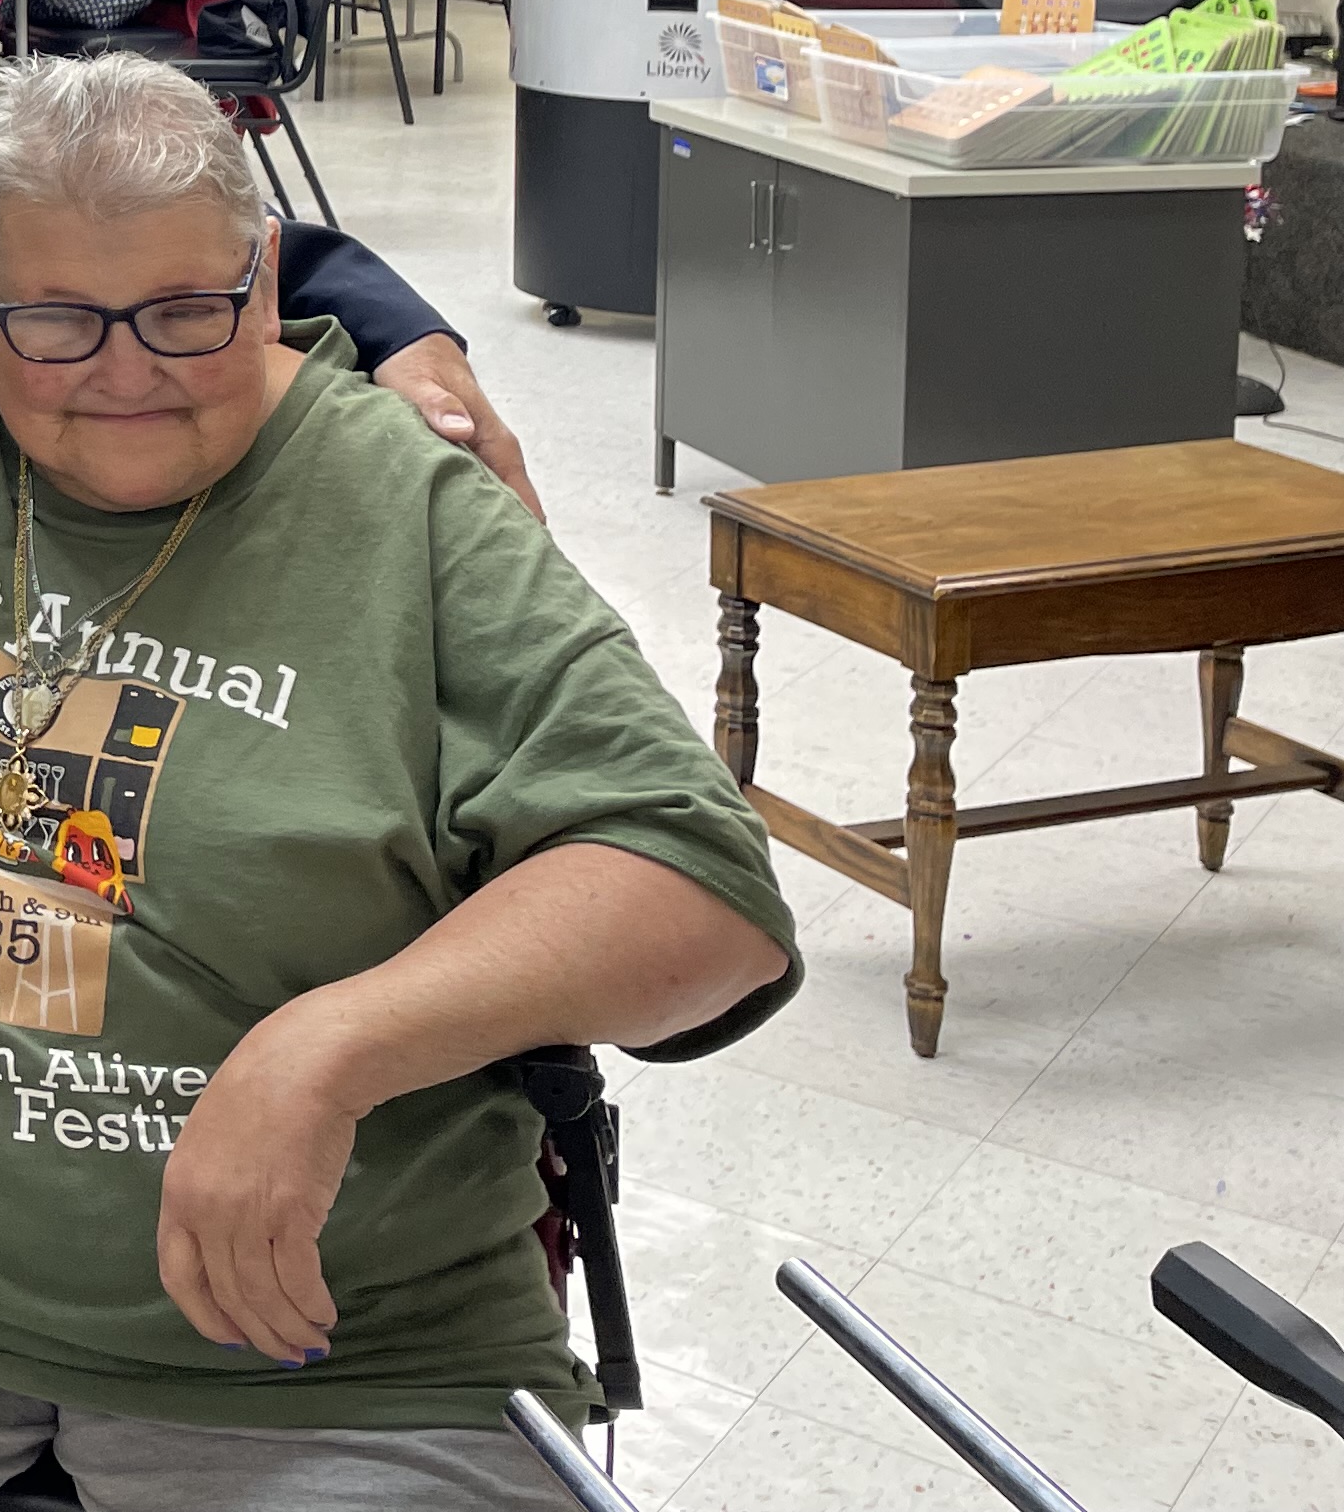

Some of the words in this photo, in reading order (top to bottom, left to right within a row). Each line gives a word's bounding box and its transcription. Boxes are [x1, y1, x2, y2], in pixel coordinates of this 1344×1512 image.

[646, 61, 711, 84] Liberty
[3, 592, 298, 731] Annual
[23, 897, 48, 917] &
[39, 1047, 208, 1097] Alive
[12, 1086, 190, 1153] Festi
